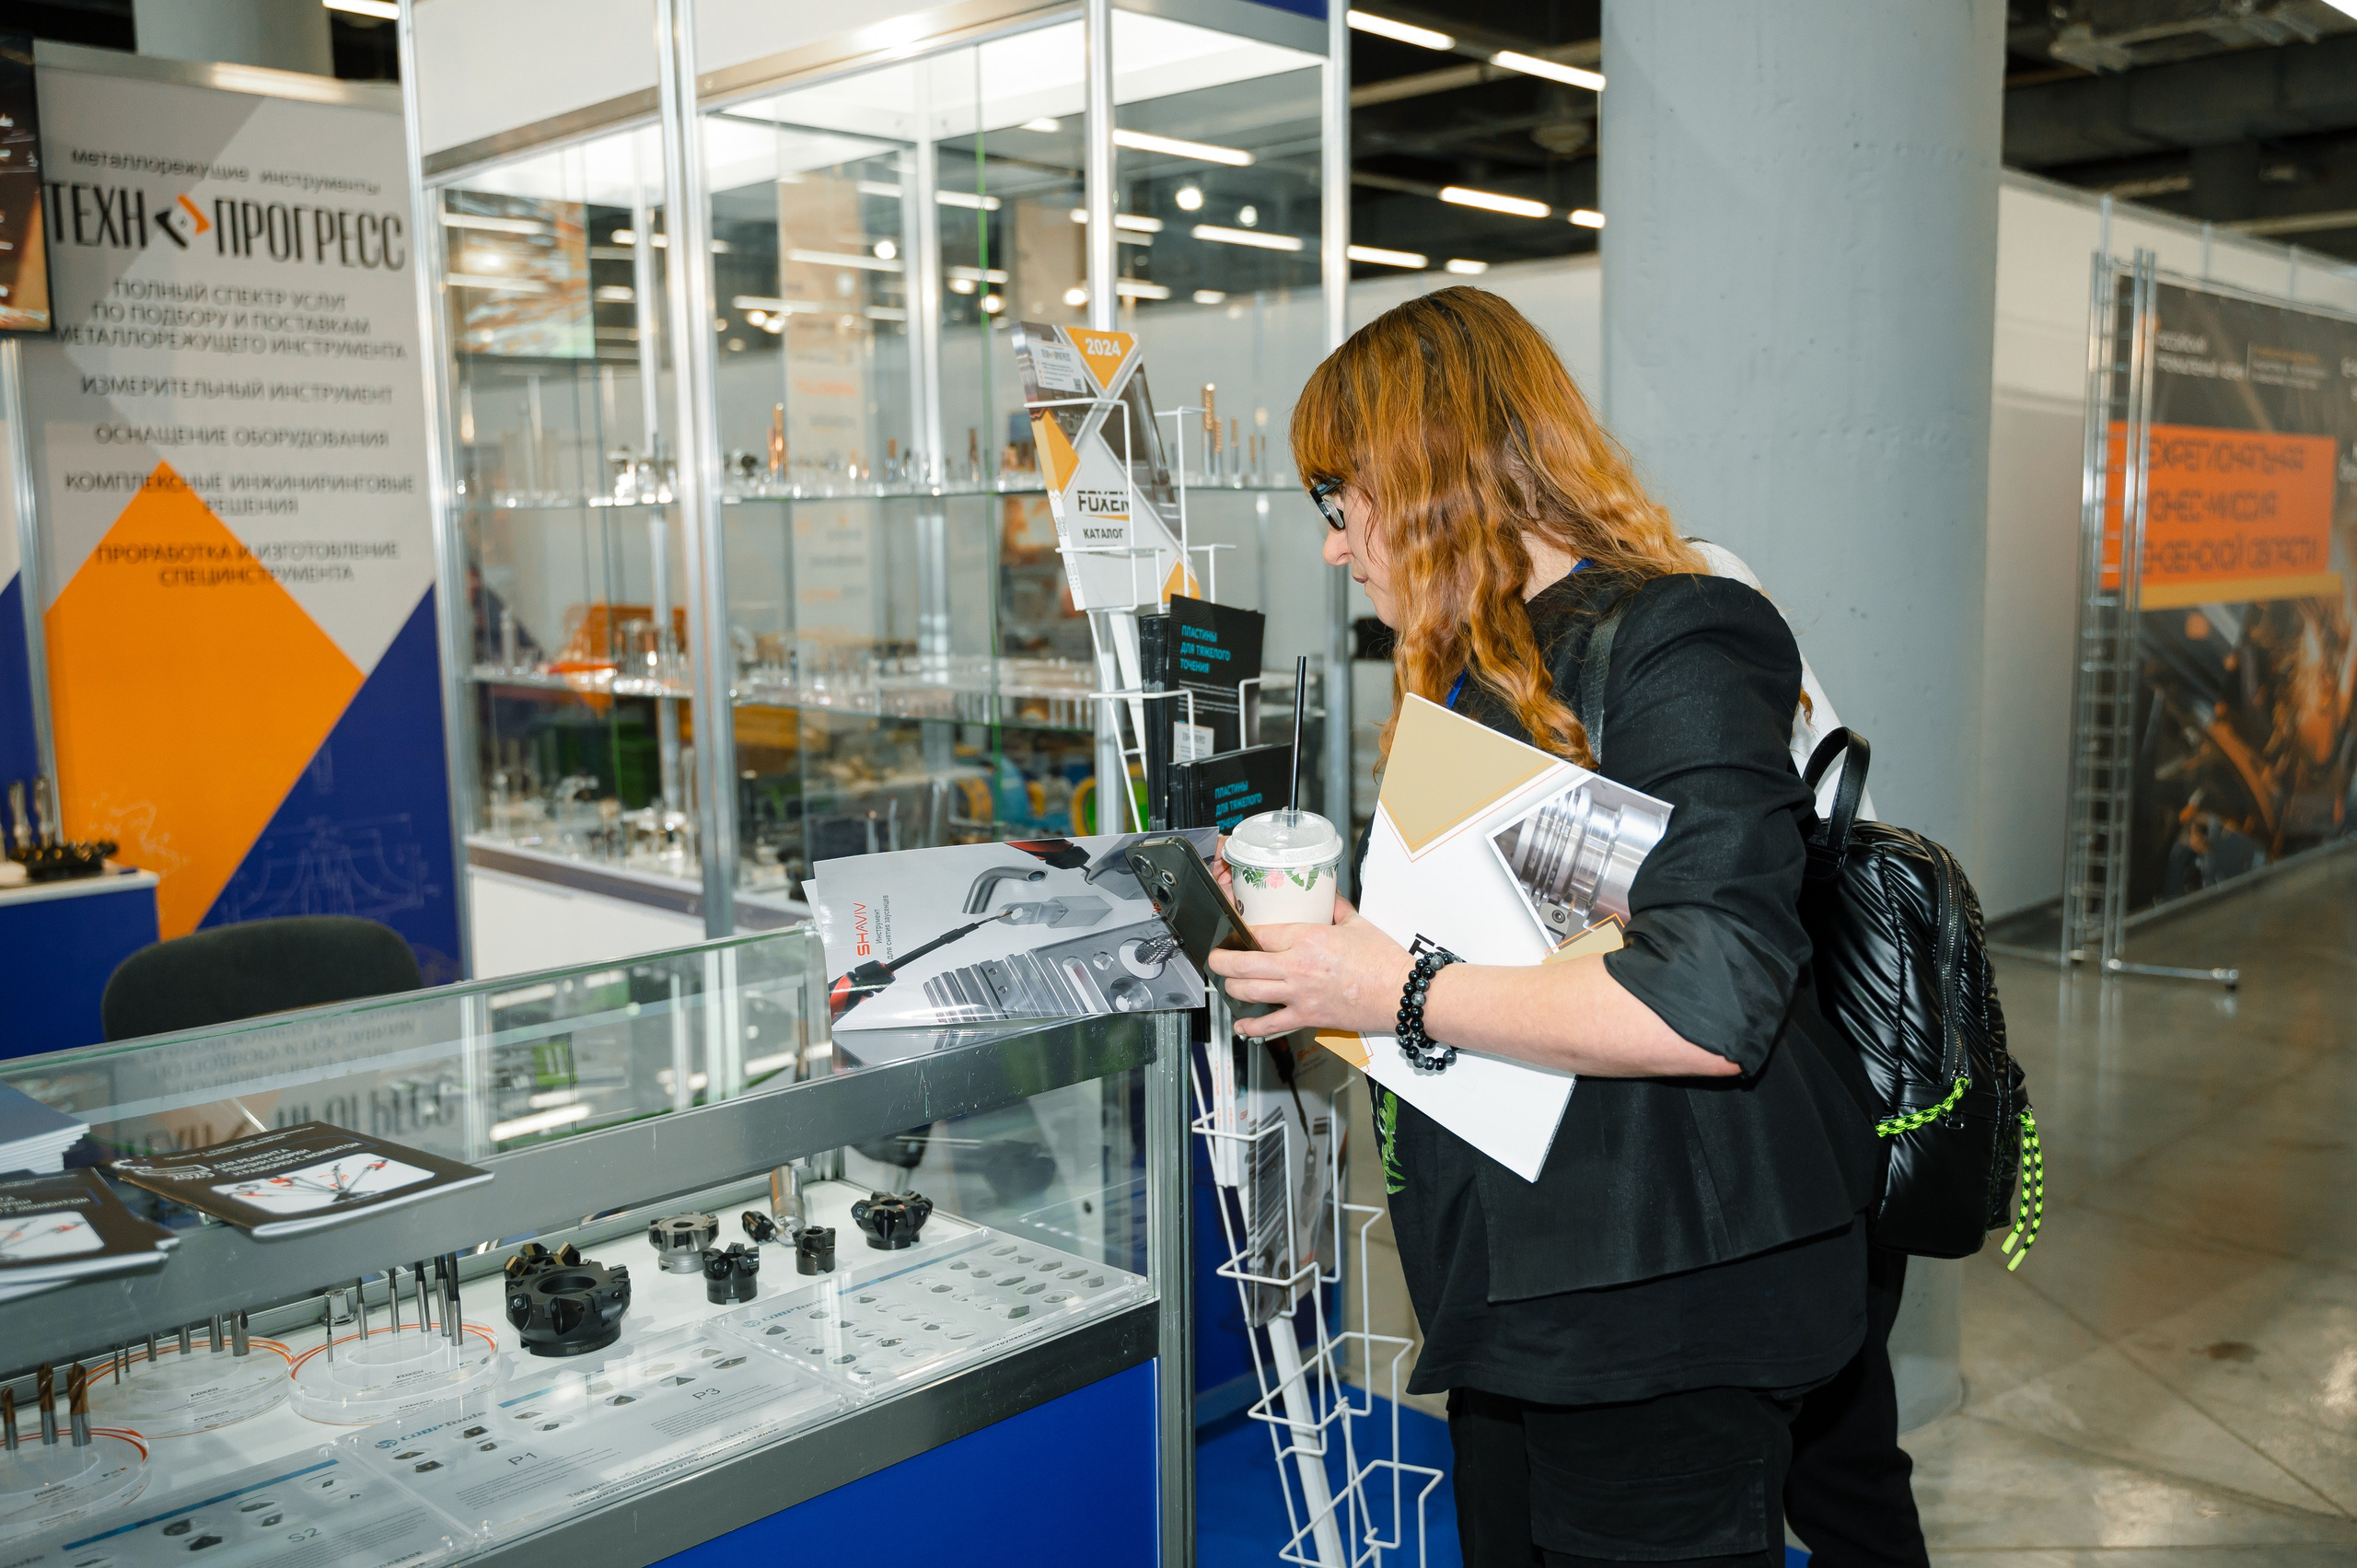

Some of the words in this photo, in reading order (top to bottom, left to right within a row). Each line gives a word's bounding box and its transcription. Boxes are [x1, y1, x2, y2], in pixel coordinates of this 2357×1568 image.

[214, 194, 405, 271] ПРОГРЕСС
[113, 277, 209, 304] ПОЛНЫЙ
[93, 300, 125, 323] ПО
[131, 304, 230, 329] ПОДБОРУ
[234, 310, 250, 329] И
[1085, 337, 1121, 356] 2024
[80, 374, 265, 401] ИЗМЕРИТЕЛЬНЫЙ
[269, 377, 393, 406] ИНСТРУМЕНТ
[95, 422, 228, 447] ОСНАЩЕНИЕ
[232, 424, 389, 449] ОБОРУДОВАНИЯ
[64, 470, 223, 494] КОМПЛЕКСНЫЕ
[1083, 528, 1123, 540] КАТАЛОГ
[95, 541, 236, 566] ПРОРАБОТКА
[1181, 624, 1217, 643] ПЛАСТИНЫ
[1180, 642, 1195, 655] ДЛЯ
[1196, 645, 1231, 662] ТЯЖЕЛОГО
[1180, 657, 1210, 674] ТОЧЕНИЯ
[1214, 780, 1248, 799] ПЛАСТИНЫ
[1215, 802, 1229, 818] ДЛЯ
[1229, 792, 1262, 810] ТЯЖЕЛОГО
[883, 894, 891, 924] заусенцев
[853, 902, 871, 956] SHAVIV
[875, 909, 883, 945] Инструмент
[884, 924, 892, 946] снятия
[886, 947, 894, 959] для
[306, 1142, 363, 1159] МОМЕНТОМ
[692, 1388, 721, 1400] P3
[508, 1452, 539, 1466] P1
[287, 1527, 322, 1542] S2
